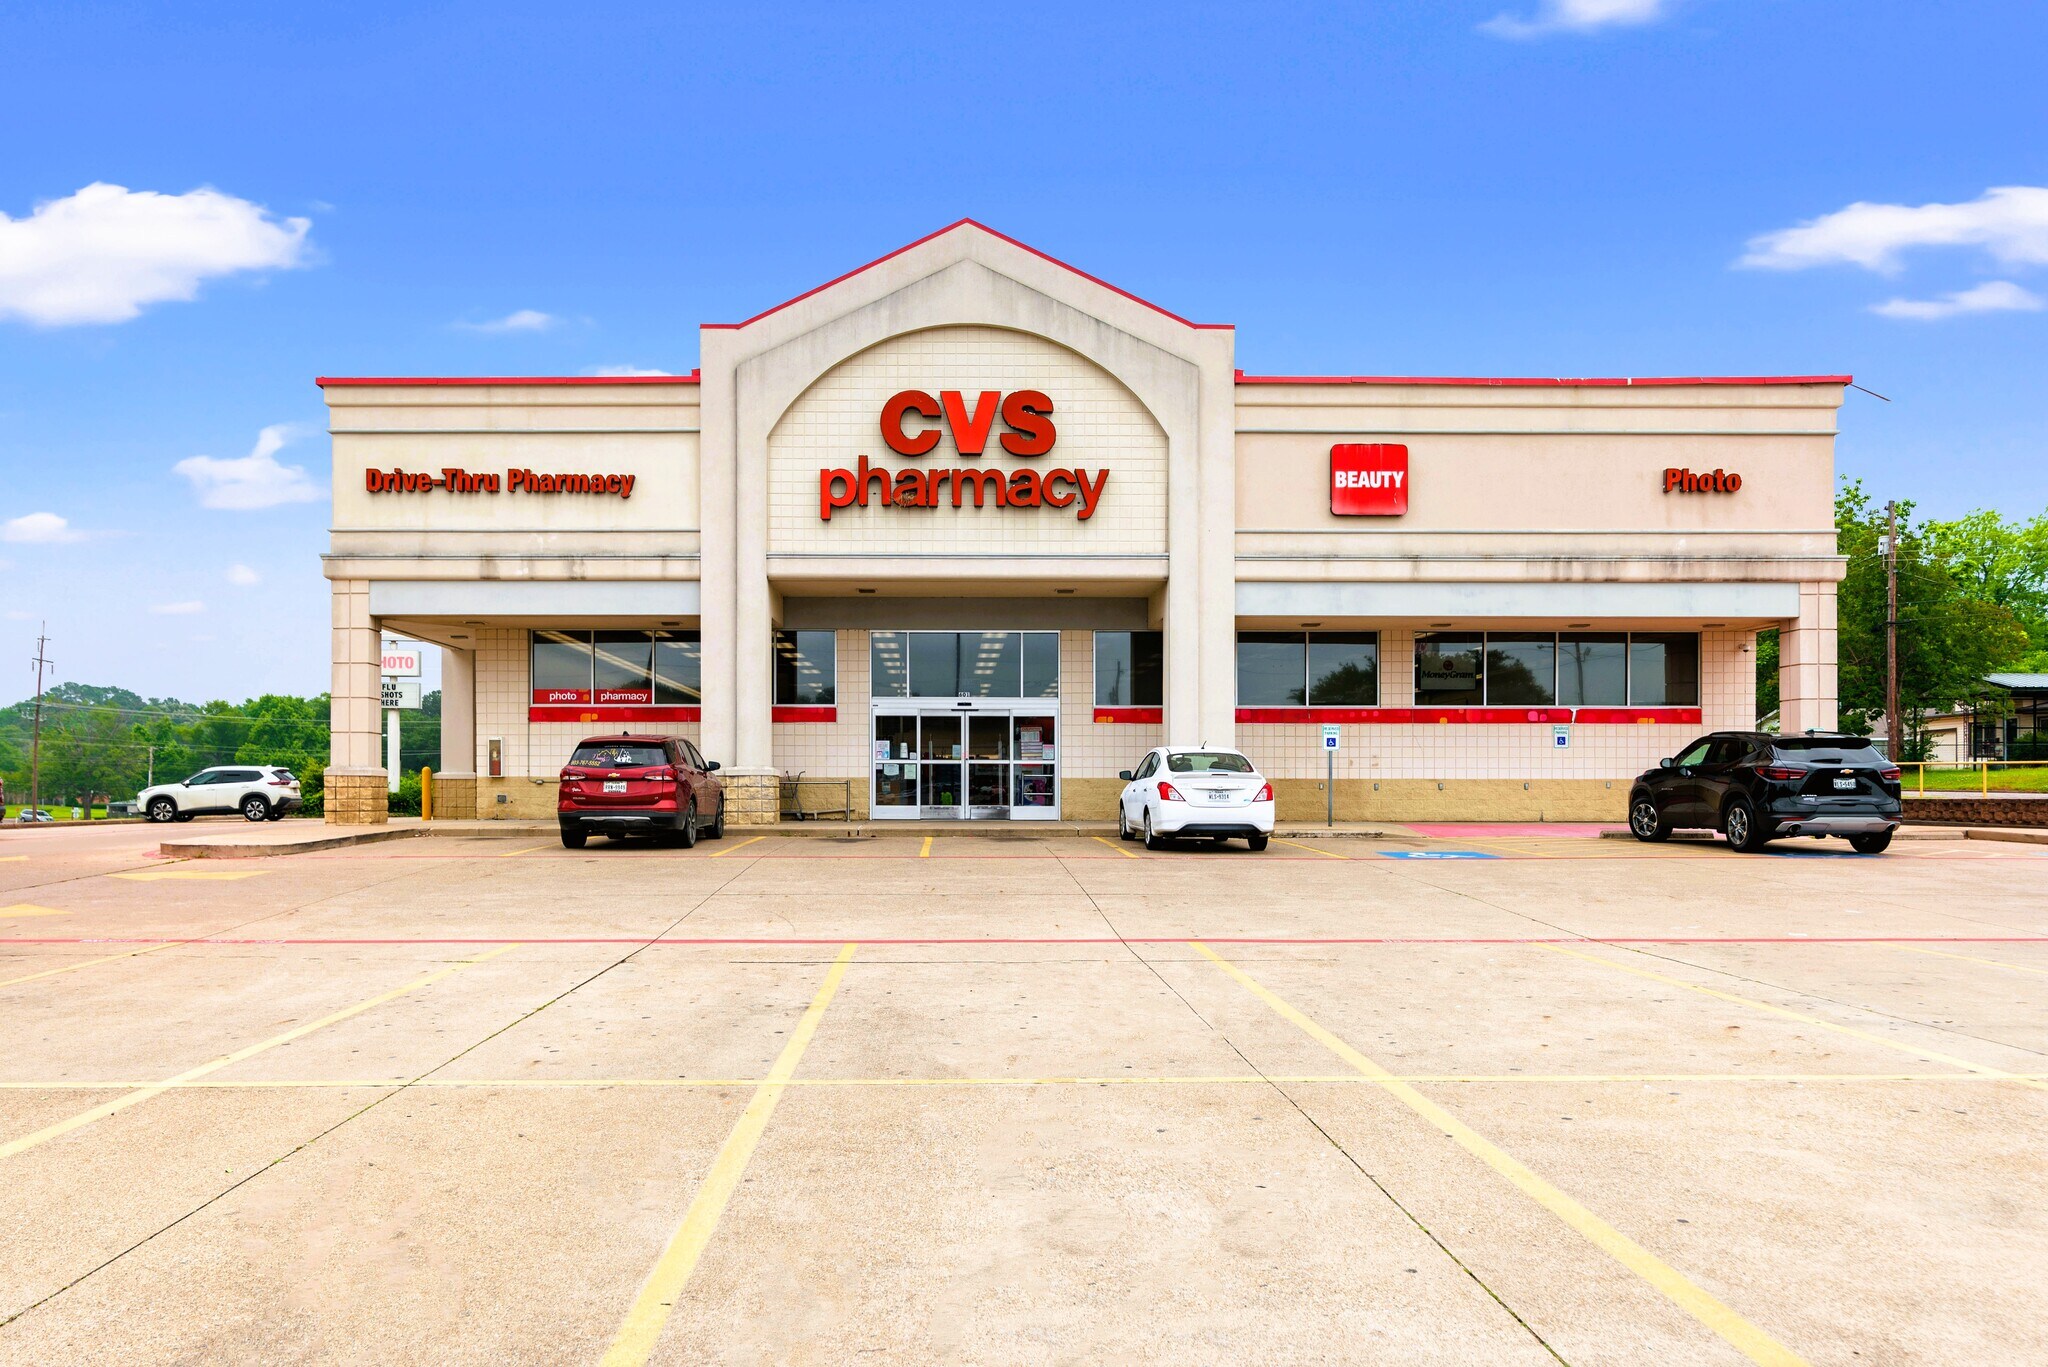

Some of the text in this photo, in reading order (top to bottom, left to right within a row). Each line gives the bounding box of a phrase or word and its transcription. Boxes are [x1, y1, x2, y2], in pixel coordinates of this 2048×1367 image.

[880, 390, 1056, 456] CVS
[366, 468, 635, 498] Drive-Thru Pharmacy
[1335, 470, 1404, 489] BEAUTY
[1663, 468, 1742, 493] Photo
[820, 455, 1109, 520] pharmacy
[381, 656, 414, 669] HOTO
[1421, 670, 1475, 680] MoneyGram
[382, 683, 397, 691] FLU
[381, 699, 399, 707] HERE
[549, 691, 577, 702] photo
[600, 691, 648, 702] pharmacy
